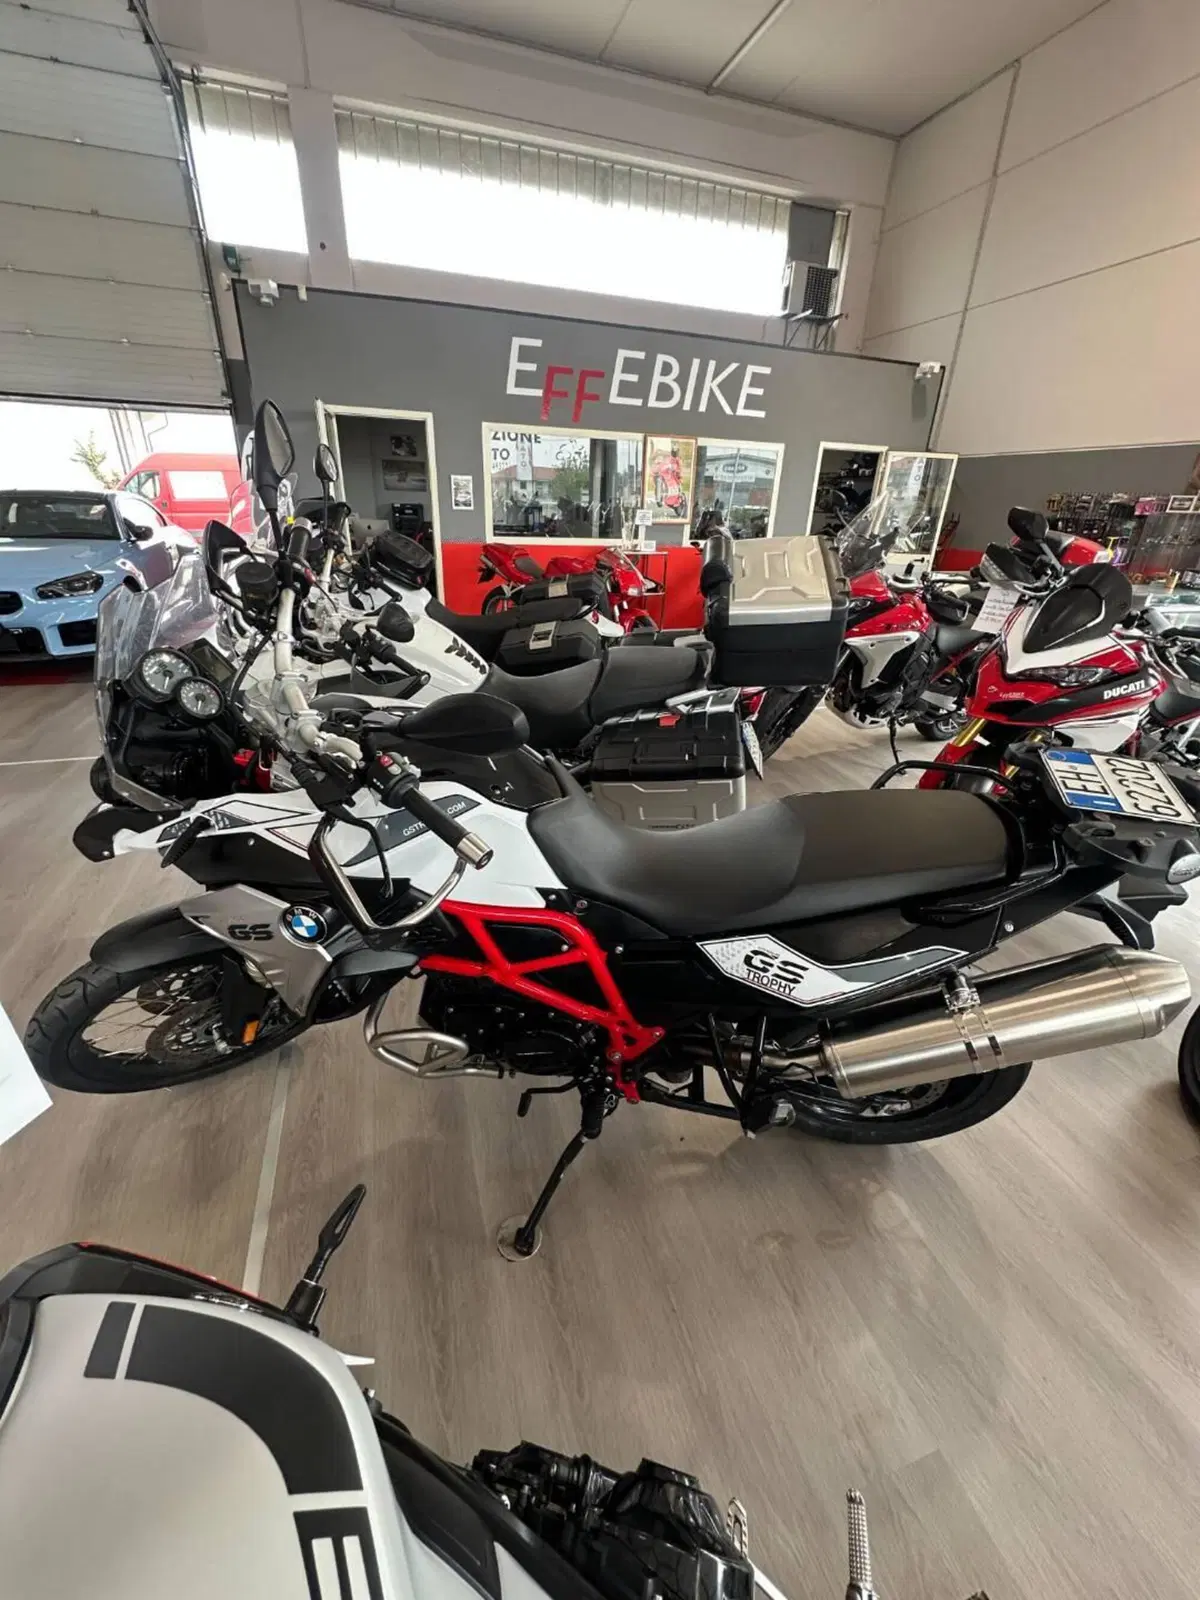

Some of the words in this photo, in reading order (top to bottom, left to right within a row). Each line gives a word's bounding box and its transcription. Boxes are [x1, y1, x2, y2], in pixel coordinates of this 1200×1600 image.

[1103, 679, 1146, 700] DUCATI
[1055, 769, 1110, 796] EH
[1105, 757, 1182, 818] 62202
[285, 907, 318, 922] BMW
[228, 923, 274, 941] GS
[743, 949, 810, 985] GS
[745, 967, 796, 997] TROPHY
